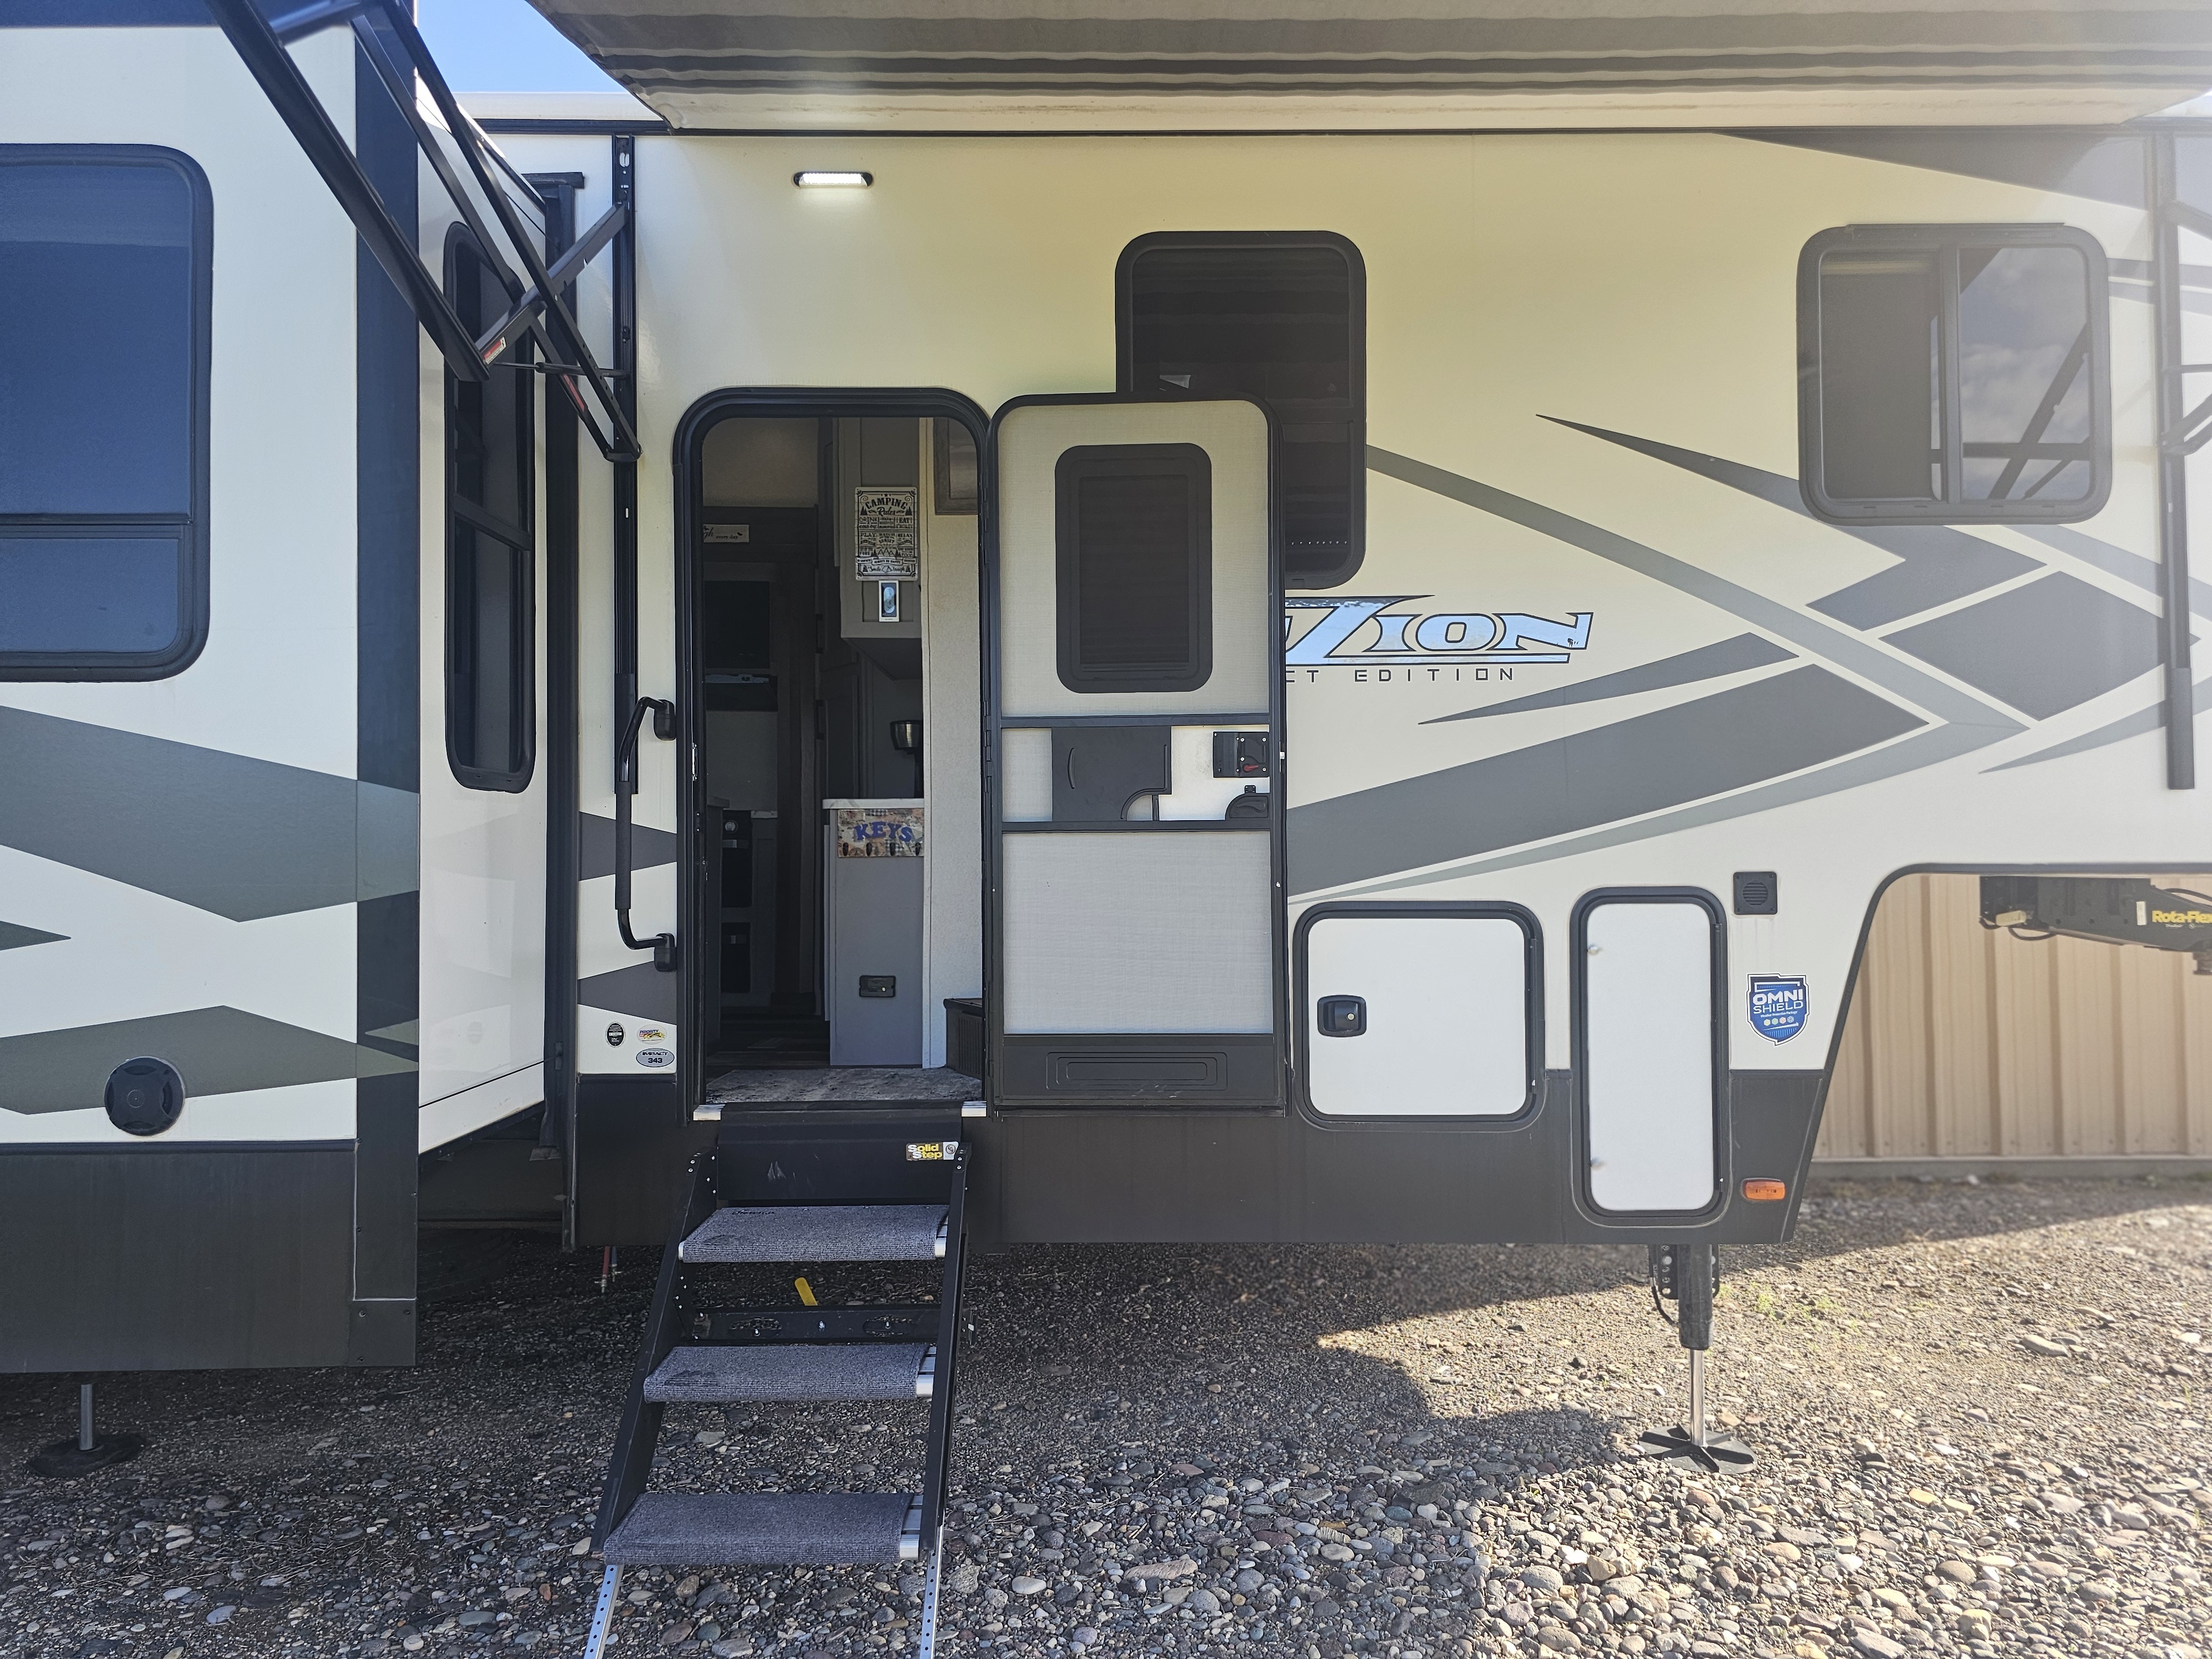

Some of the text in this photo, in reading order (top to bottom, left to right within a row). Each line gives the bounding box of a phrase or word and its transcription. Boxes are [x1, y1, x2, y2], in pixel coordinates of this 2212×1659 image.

[865, 497, 908, 510] CAMPING
[877, 507, 895, 517] Rules
[1354, 667, 1512, 682] EDITION
[854, 821, 913, 842] KEYS
[2152, 910, 2212, 923] Rota-Fle
[1752, 989, 1803, 1005] OMNI
[1752, 1000, 1804, 1014] SHIELD
[907, 1143, 939, 1152] Solid
[912, 1151, 943, 1160] Step
